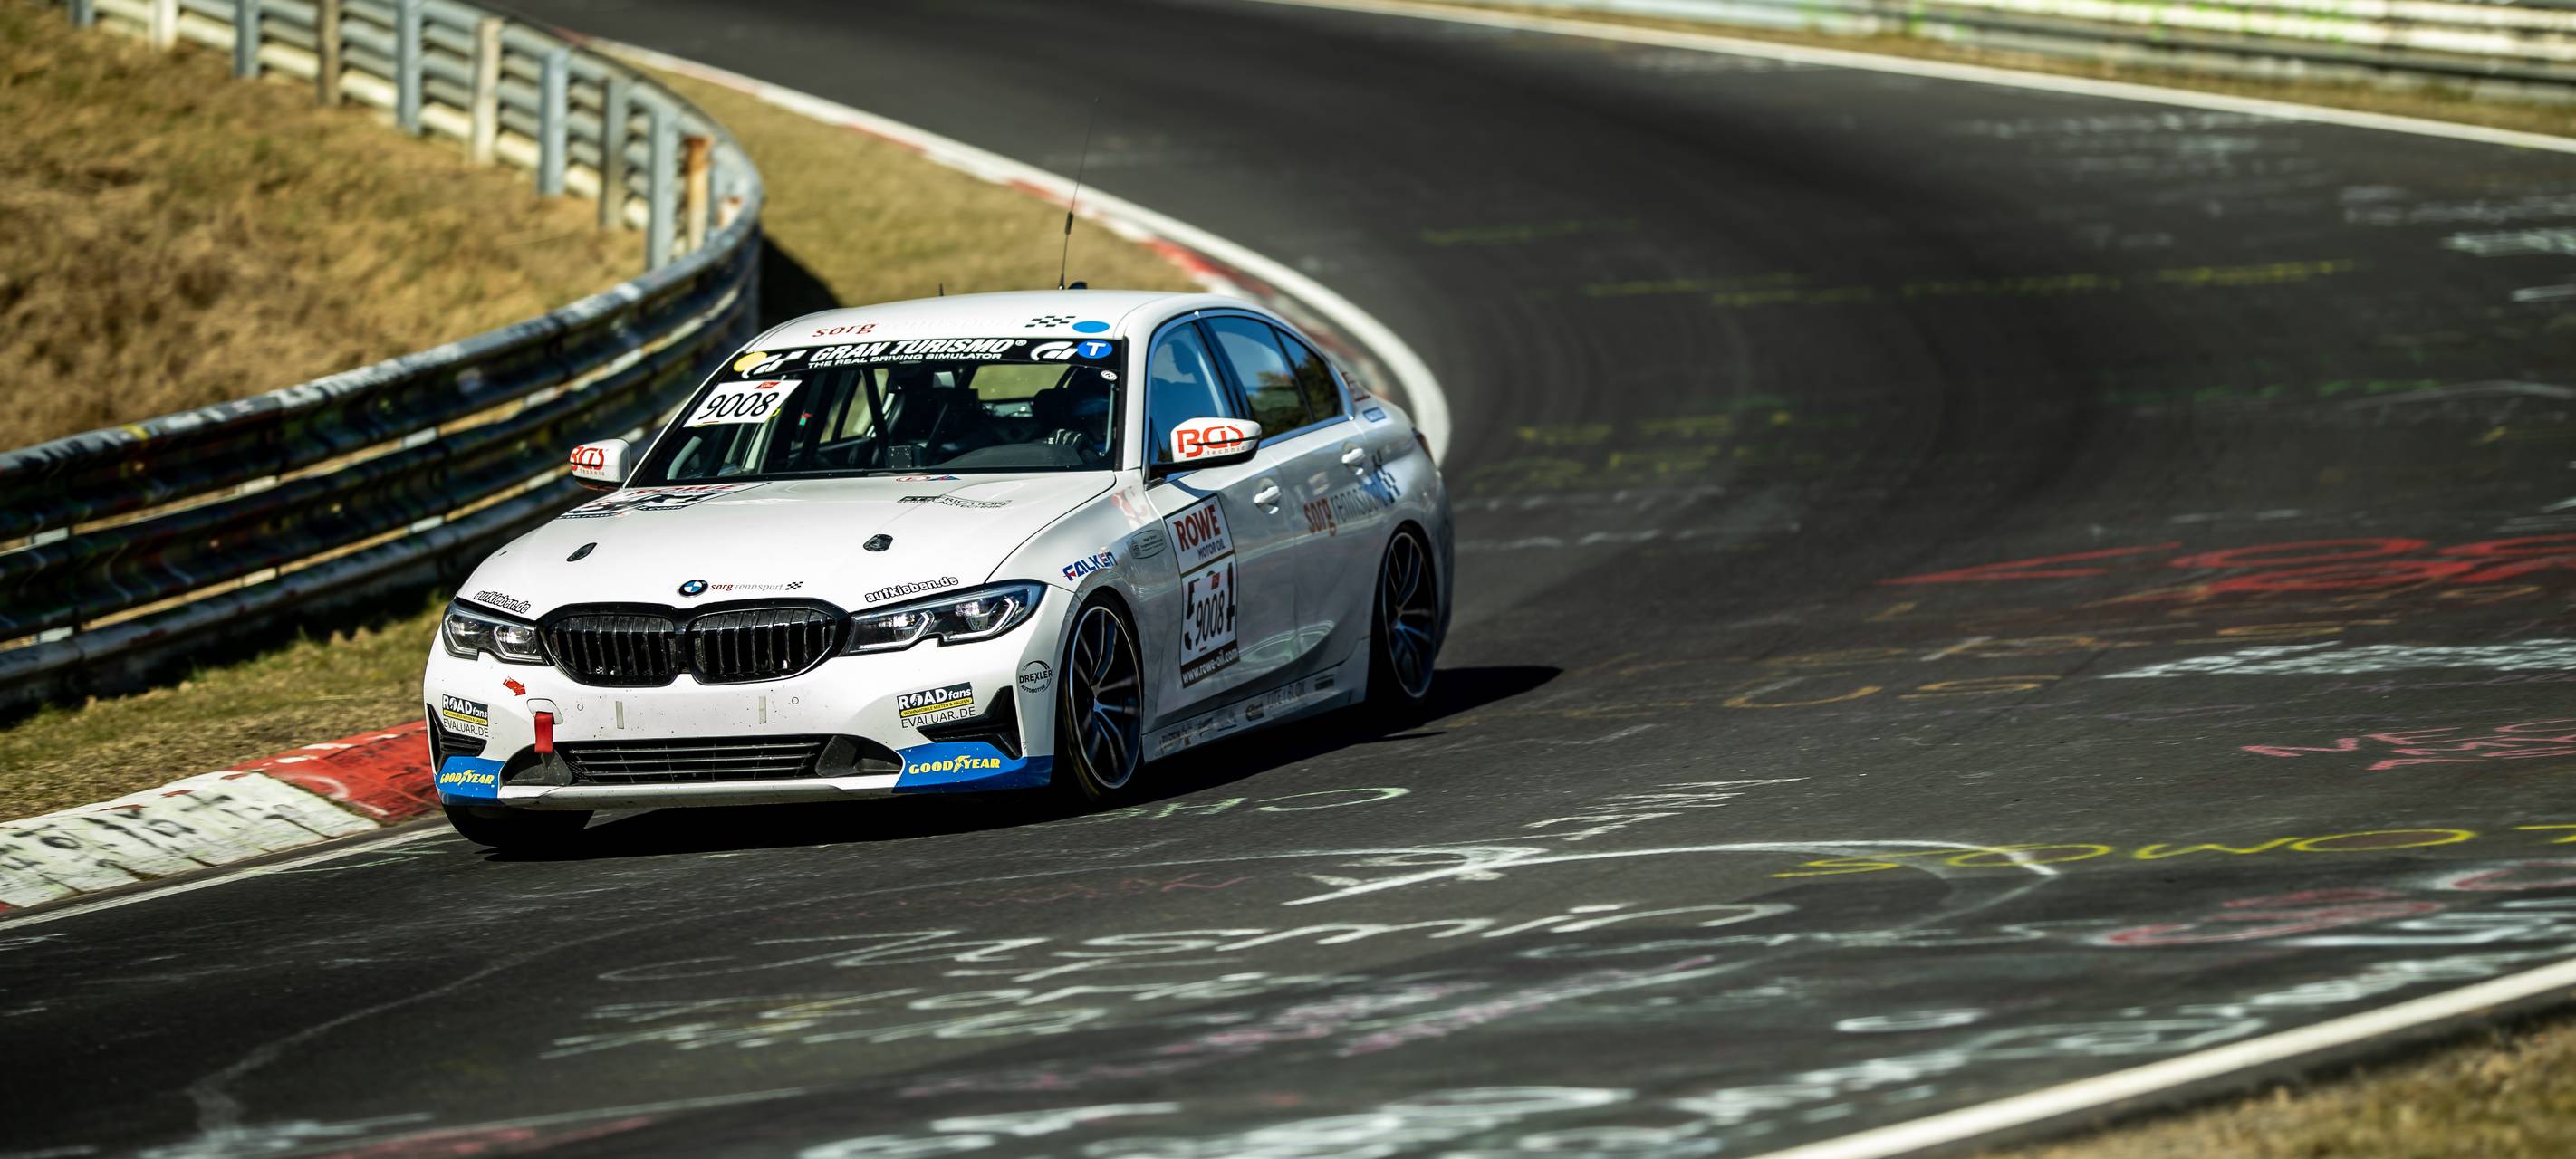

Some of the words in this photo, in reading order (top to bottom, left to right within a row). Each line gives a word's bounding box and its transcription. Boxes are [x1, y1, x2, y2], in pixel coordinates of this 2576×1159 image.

[812, 323, 878, 338] sorg
[808, 360, 831, 369] THE
[831, 357, 868, 366] REAL
[870, 353, 924, 363] DRIVING
[927, 352, 1003, 360] SIMULATOR
[809, 340, 891, 362] GRAN
[697, 391, 780, 421] 9008
[1173, 503, 1222, 552] ROWE
[709, 583, 734, 591] sorg
[735, 583, 783, 591] rennsport
[864, 573, 959, 604] aufkleben.de
[473, 589, 531, 614] aufkleben.de
[1195, 589, 1225, 647] 9008
[1018, 669, 1053, 684] DREXLER
[443, 718, 489, 738] EVALUAR.DE
[901, 706, 976, 729] EVALUAR.DE
[908, 755, 1001, 774] GOODYEAR
[439, 769, 495, 786] GOODYEAR
